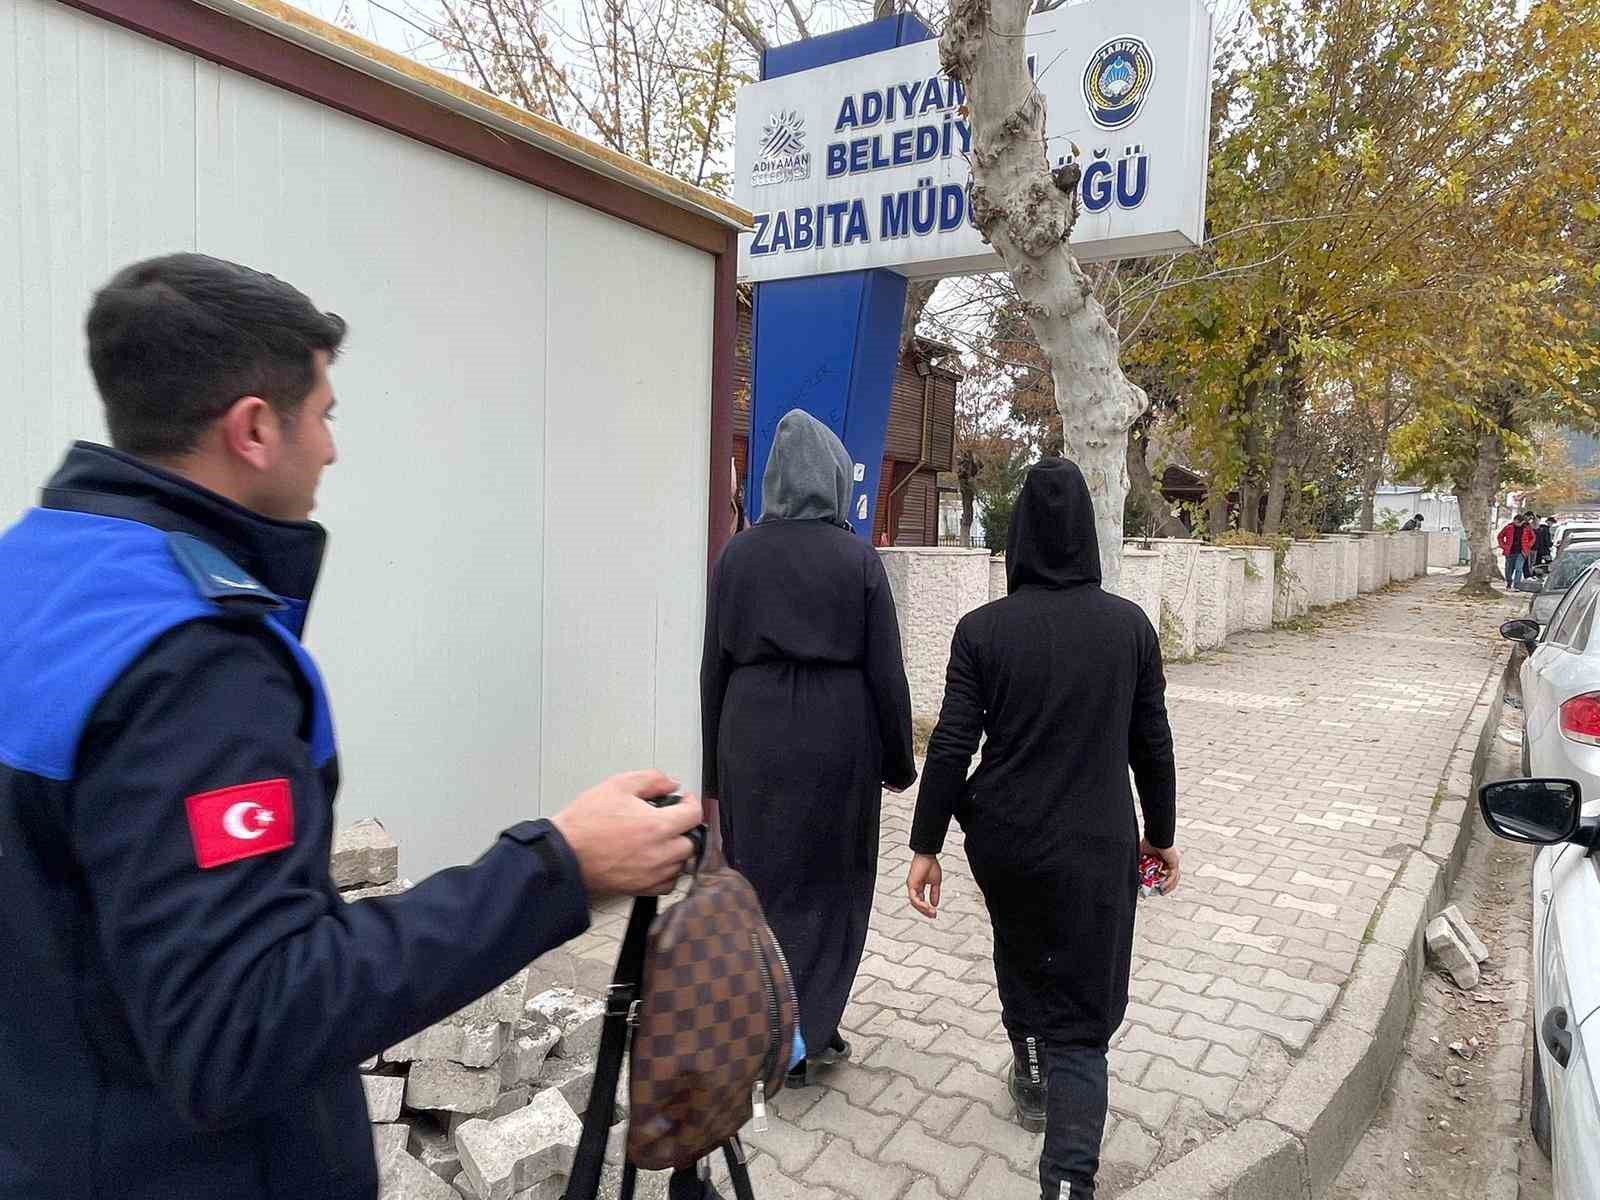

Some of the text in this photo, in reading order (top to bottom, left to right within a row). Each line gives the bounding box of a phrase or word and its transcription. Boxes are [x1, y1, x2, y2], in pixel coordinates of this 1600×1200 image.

[1101, 42, 1139, 60] ZABITA
[752, 153, 808, 172] ADIYAMAN
[827, 114, 972, 177] BELEDİY
[750, 199, 869, 255] ZABITA
